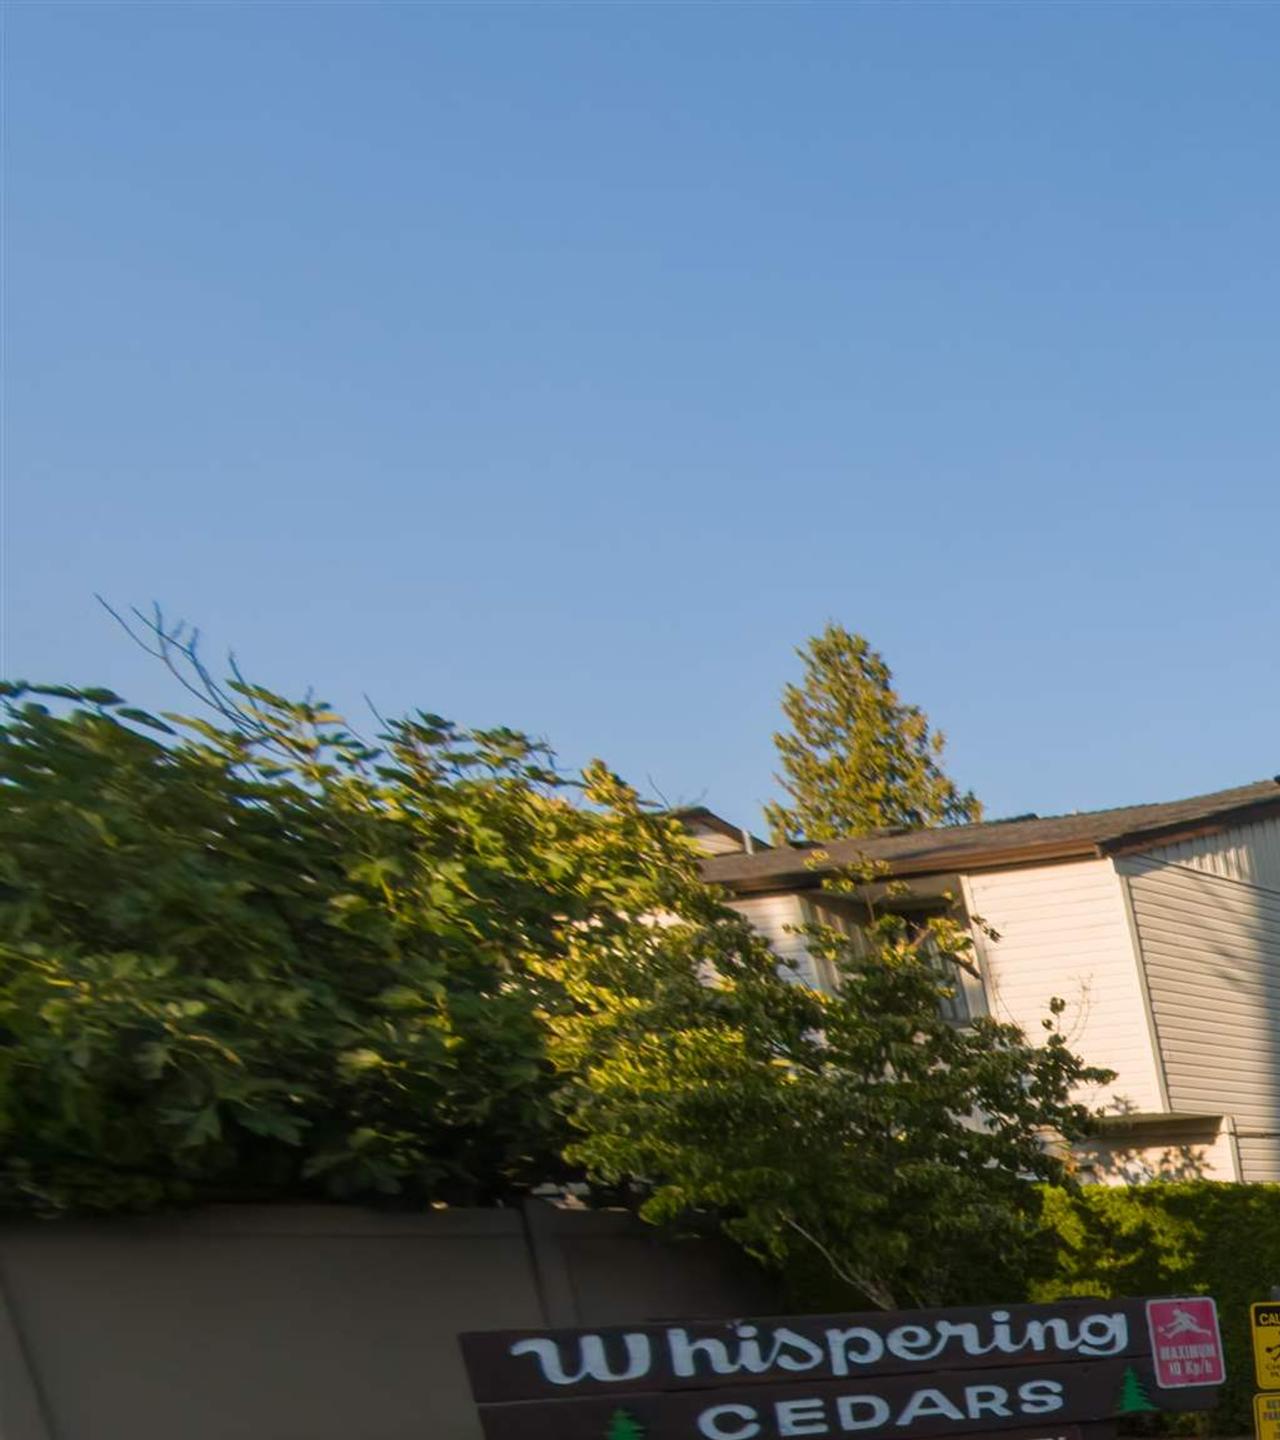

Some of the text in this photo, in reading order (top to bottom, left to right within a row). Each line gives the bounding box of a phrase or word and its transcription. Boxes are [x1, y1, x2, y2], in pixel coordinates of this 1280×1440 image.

[510, 1310, 1129, 1385] Whispering
[1160, 1344, 1215, 1360] MAXIMUM
[697, 1380, 1064, 1440] CEDARS
